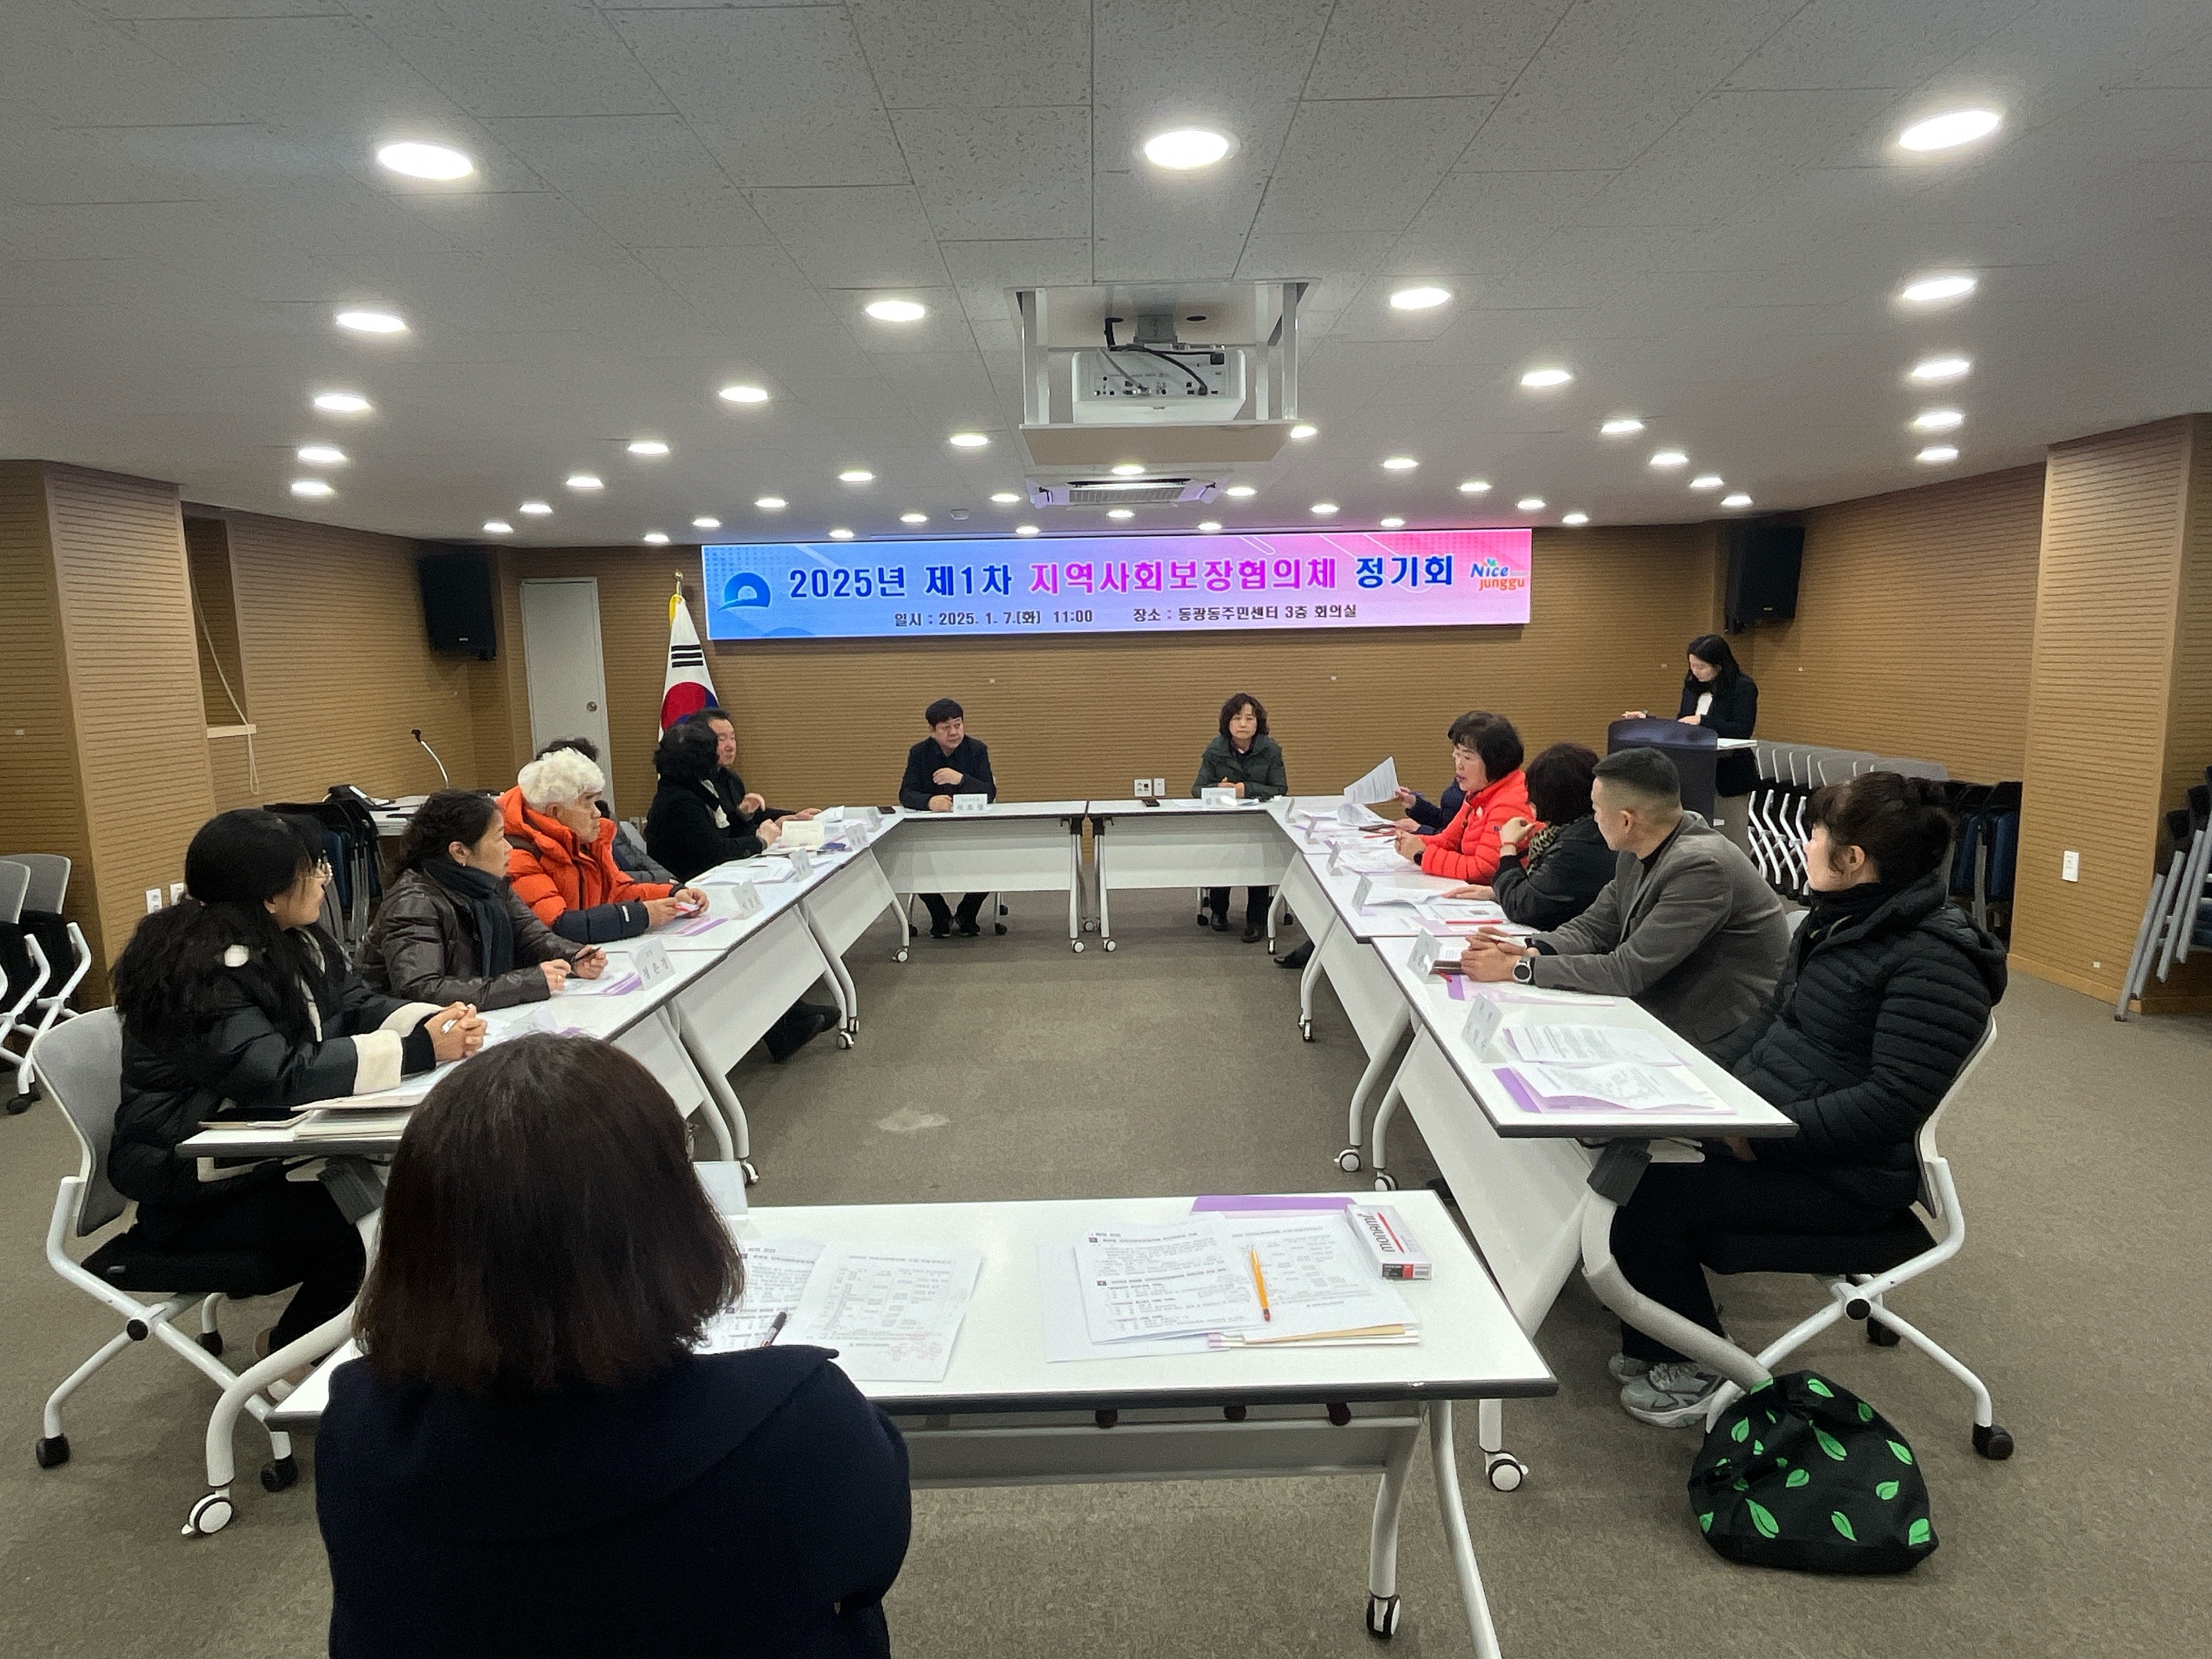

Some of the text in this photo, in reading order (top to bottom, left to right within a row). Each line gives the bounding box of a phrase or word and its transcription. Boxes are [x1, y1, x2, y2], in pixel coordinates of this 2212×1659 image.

[790, 555, 1452, 598] 2025년 제1차 지역사회보장협의체 정기회
[1470, 562, 1508, 578] Nice
[1479, 578, 1525, 591] junggu
[894, 612, 922, 627] 일시
[939, 612, 979, 625] 2025.
[1053, 610, 1093, 623] 11:00
[1133, 608, 1161, 622] 장소
[1178, 606, 1278, 621] 동광동주민센터
[1284, 605, 1308, 619] 3층
[1314, 604, 1356, 618] 회의실
